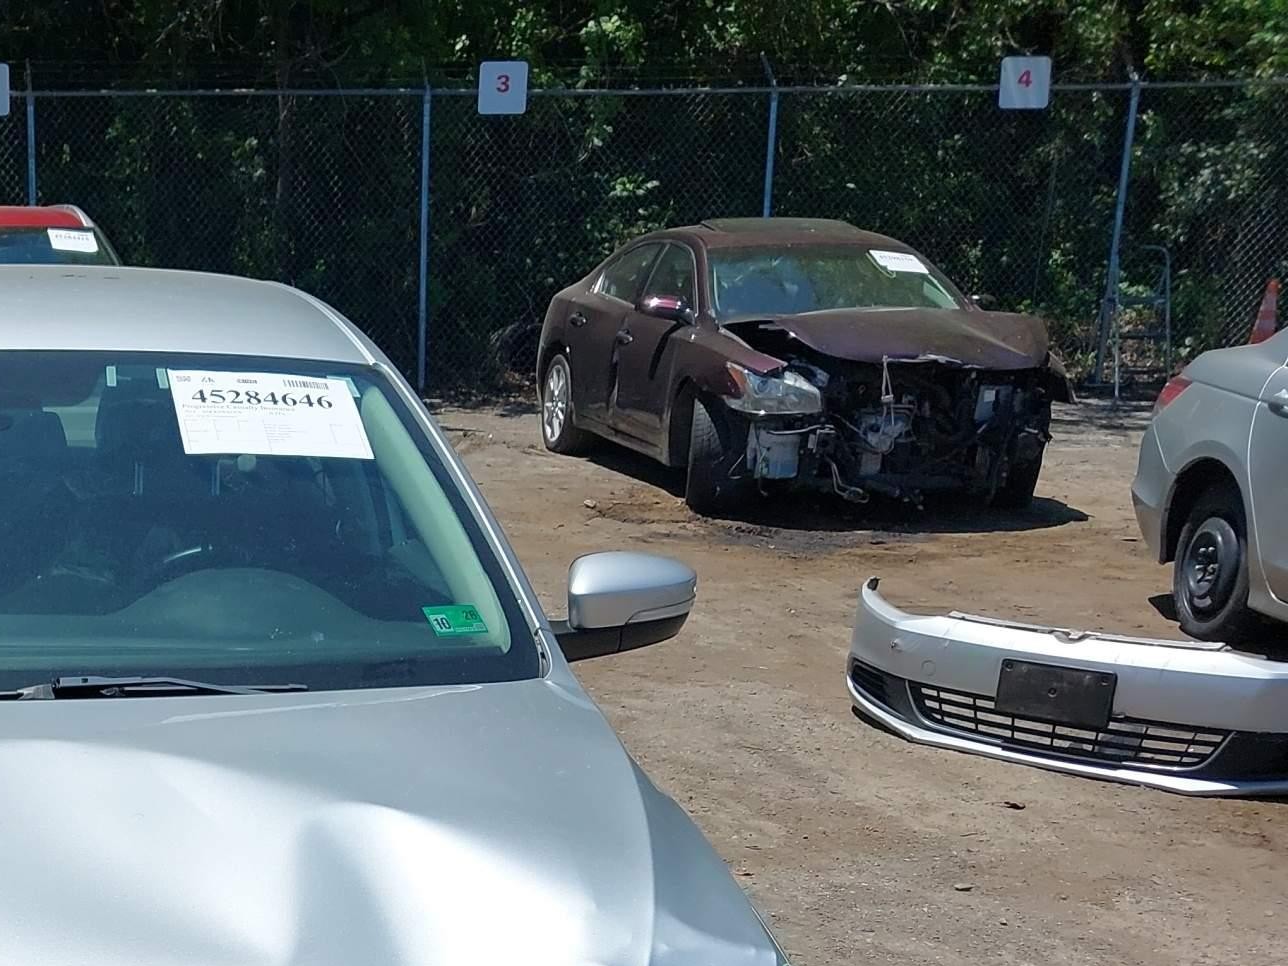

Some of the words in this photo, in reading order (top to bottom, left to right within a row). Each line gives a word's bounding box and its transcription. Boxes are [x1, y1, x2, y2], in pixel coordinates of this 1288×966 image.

[496, 74, 510, 92] 3
[1017, 70, 1033, 88] 4
[191, 388, 333, 409] 45284646
[433, 617, 452, 630] 10
